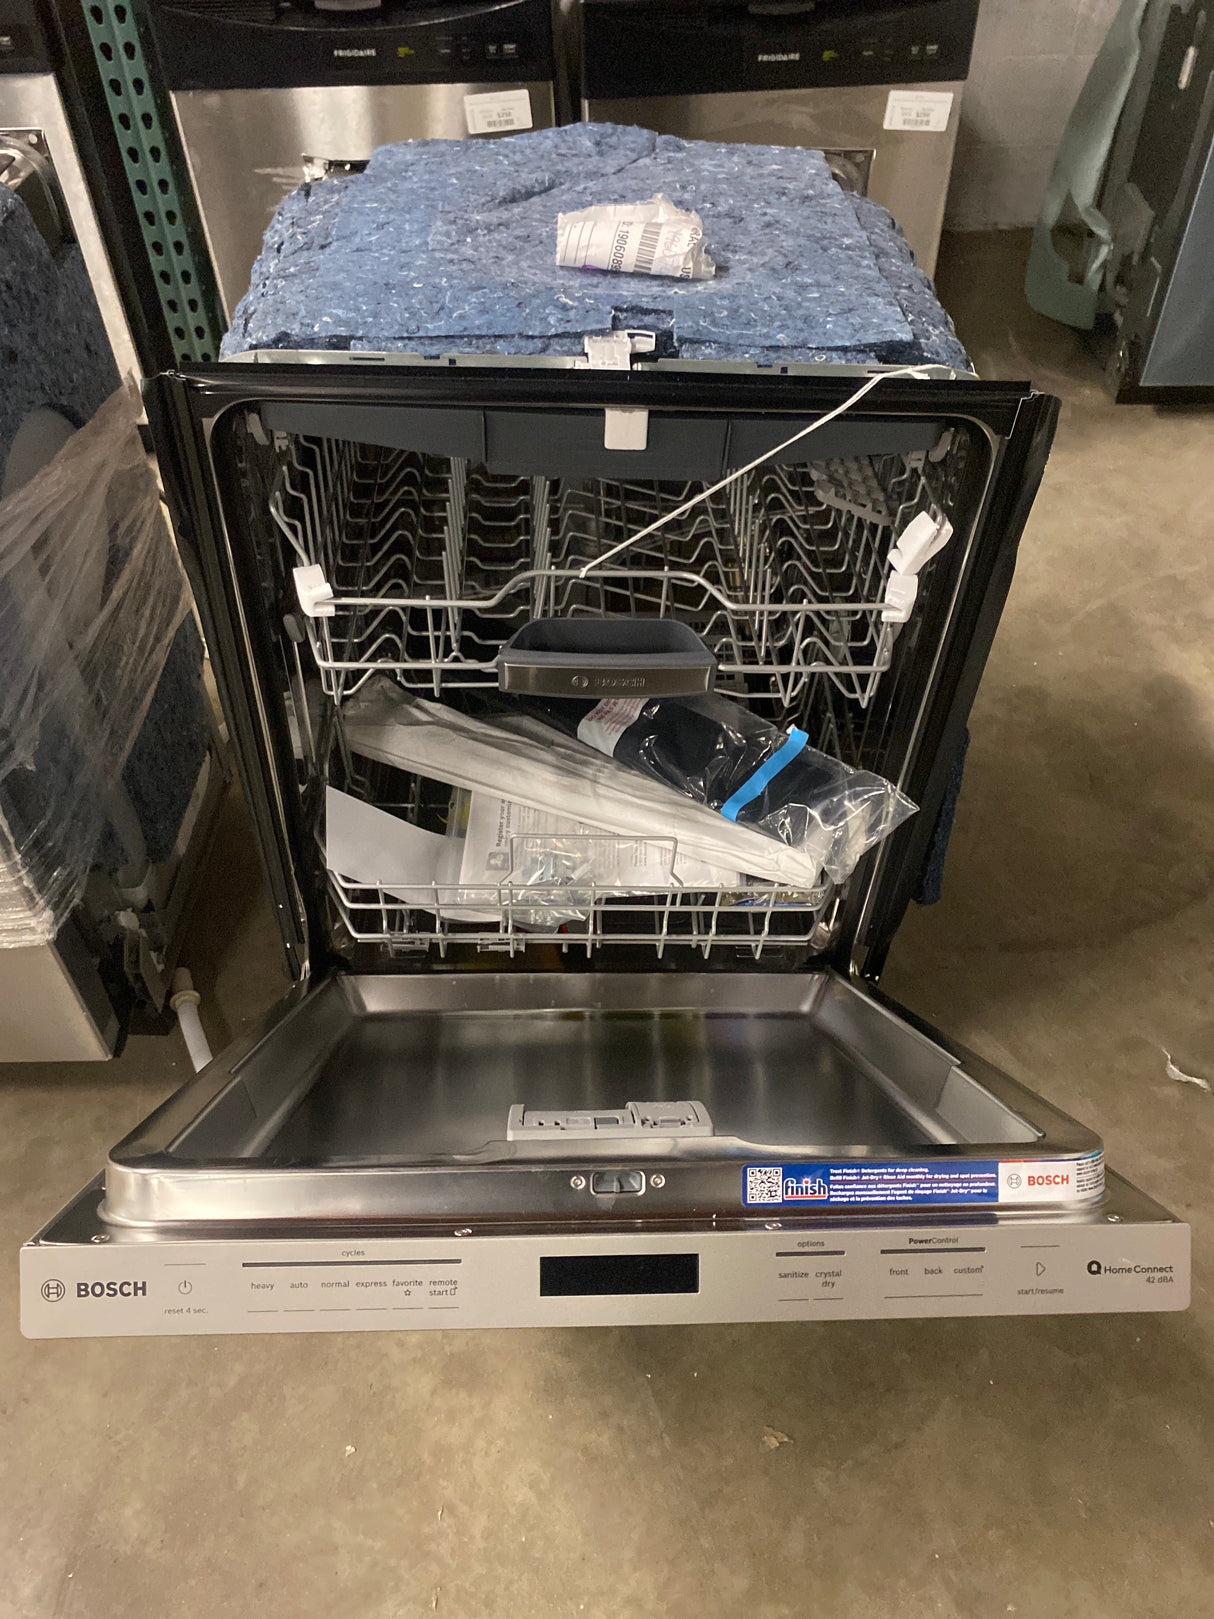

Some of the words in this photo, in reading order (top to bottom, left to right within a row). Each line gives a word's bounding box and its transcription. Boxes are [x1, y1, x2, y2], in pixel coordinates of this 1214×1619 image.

[1028, 1174, 1069, 1186] BOSCH
[784, 1178, 828, 1198] finish
[909, 1237, 959, 1245] PowerControl
[341, 1249, 366, 1257] cycles
[778, 1271, 809, 1279] sanitize
[815, 1269, 842, 1279] crystal
[924, 1267, 943, 1275] back
[1157, 1275, 1174, 1283] dBA
[251, 1282, 275, 1291] heavy
[289, 1281, 309, 1289] auto
[392, 1279, 424, 1287] favorite
[822, 1280, 836, 1288] dry
[76, 1281, 147, 1298] BOSCH
[429, 1288, 449, 1296] start
[1017, 1287, 1064, 1295] start/resume
[164, 1307, 184, 1315] reset
[186, 1306, 192, 1315] 4
[193, 1306, 209, 1315] sec.
